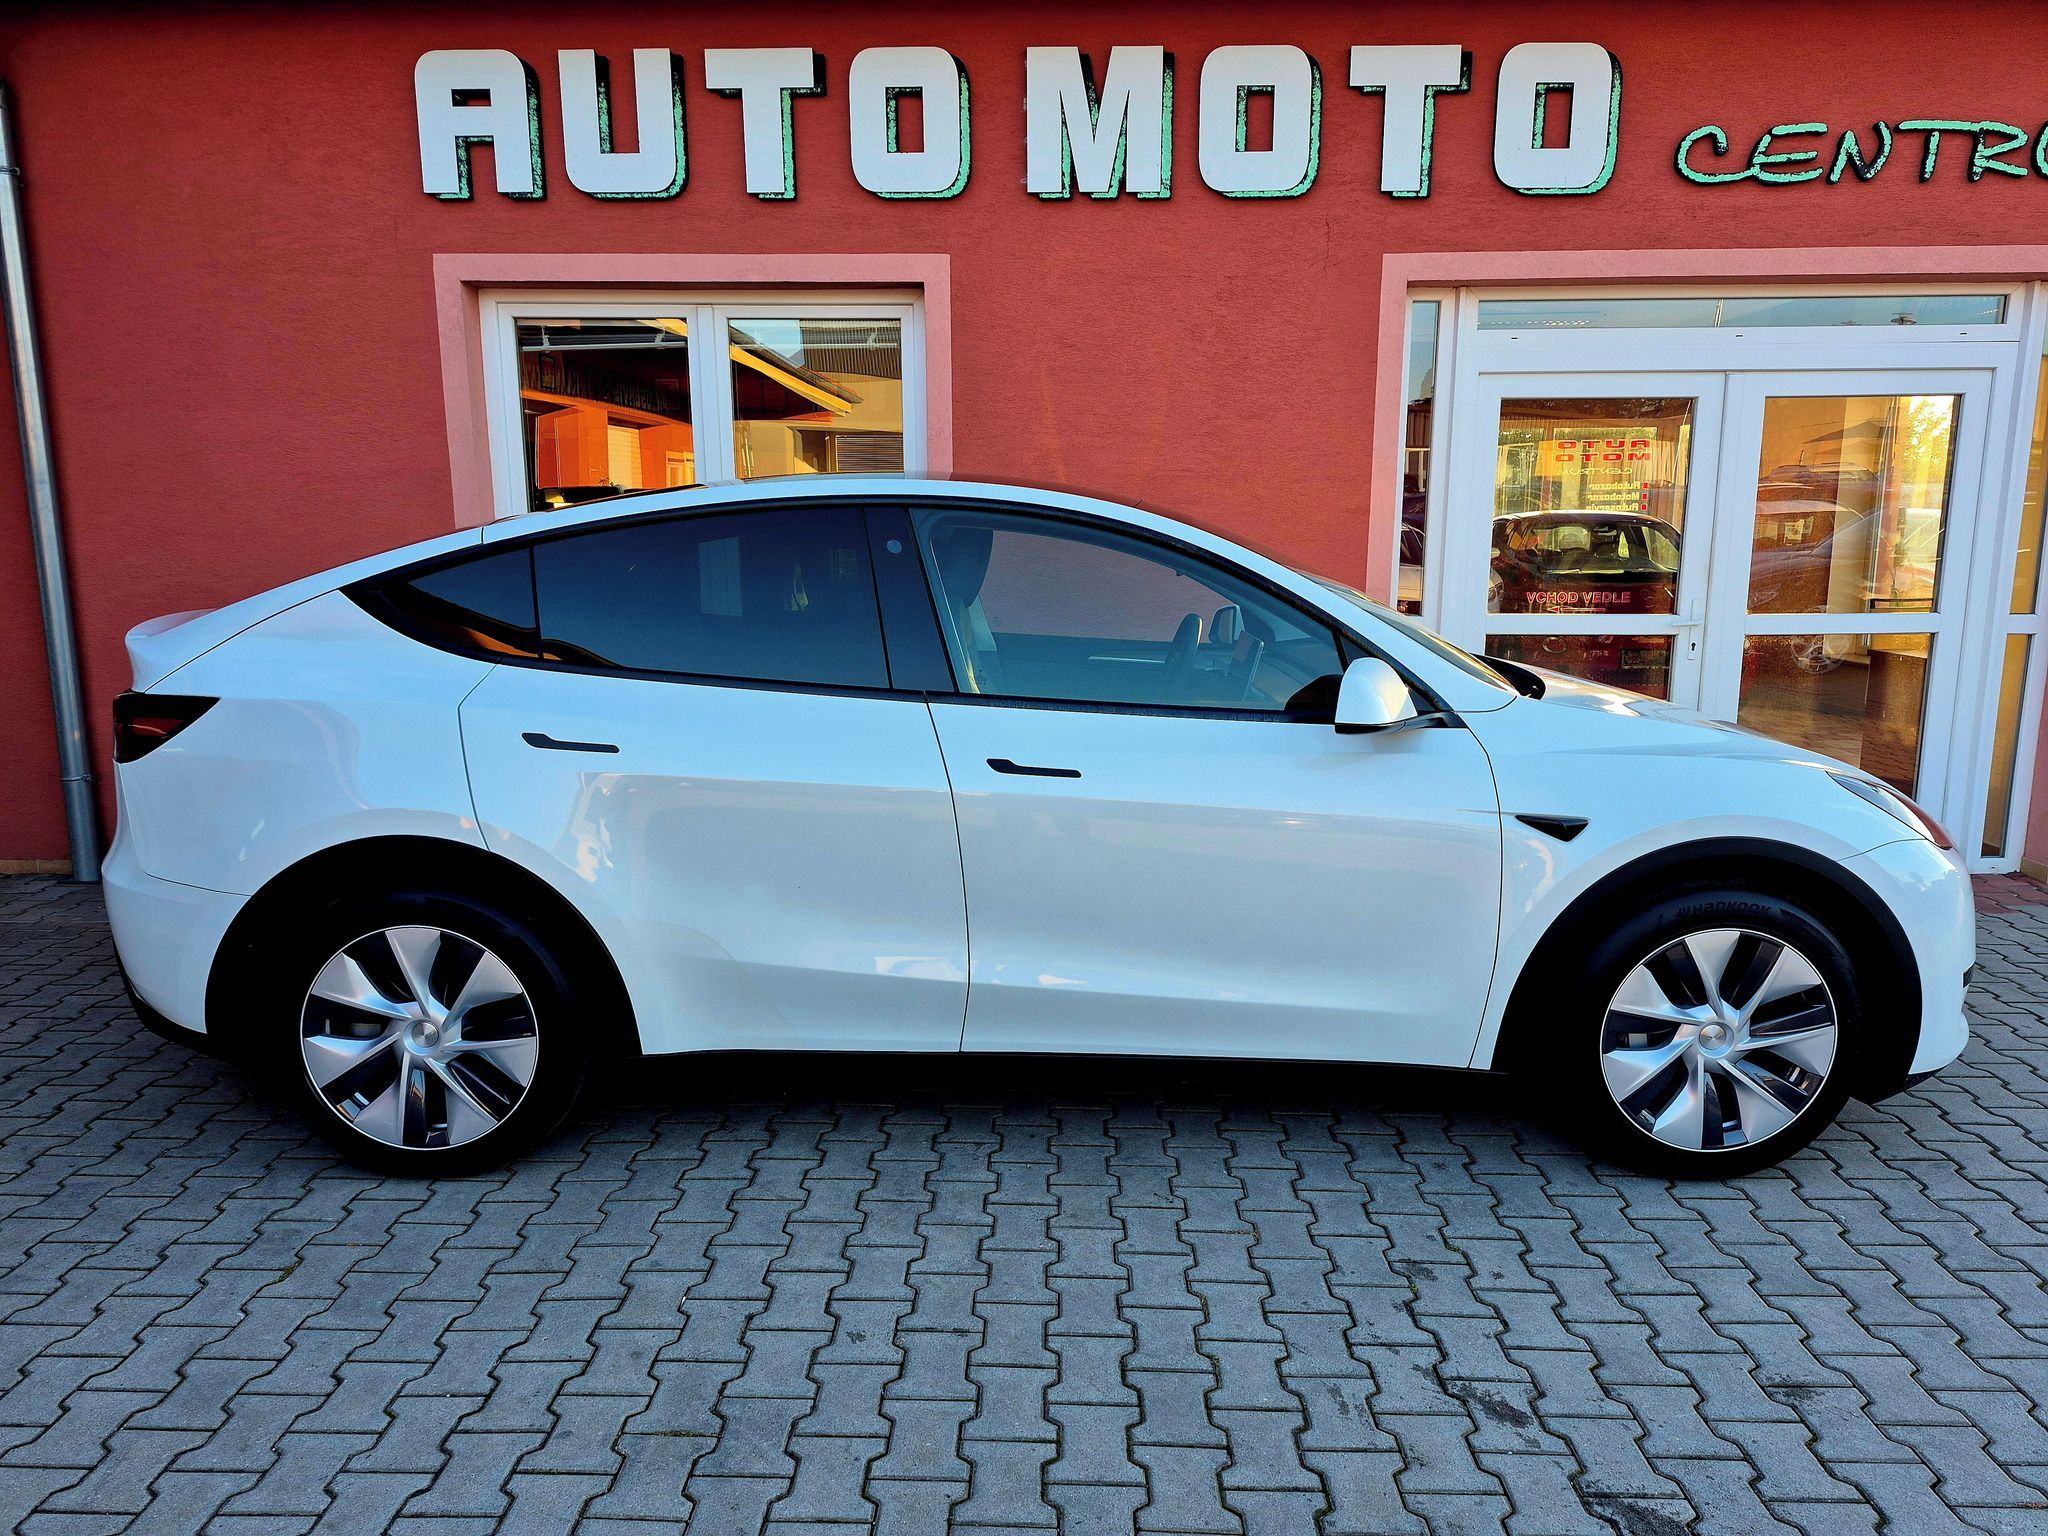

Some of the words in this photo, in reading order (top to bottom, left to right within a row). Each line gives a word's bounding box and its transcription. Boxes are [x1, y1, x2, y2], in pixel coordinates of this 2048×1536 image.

[414, 47, 972, 200] AUTO
[1022, 42, 1623, 199] MOTO
[1526, 591, 1579, 604] VCHOD
[1582, 591, 1631, 604] VEDLE
